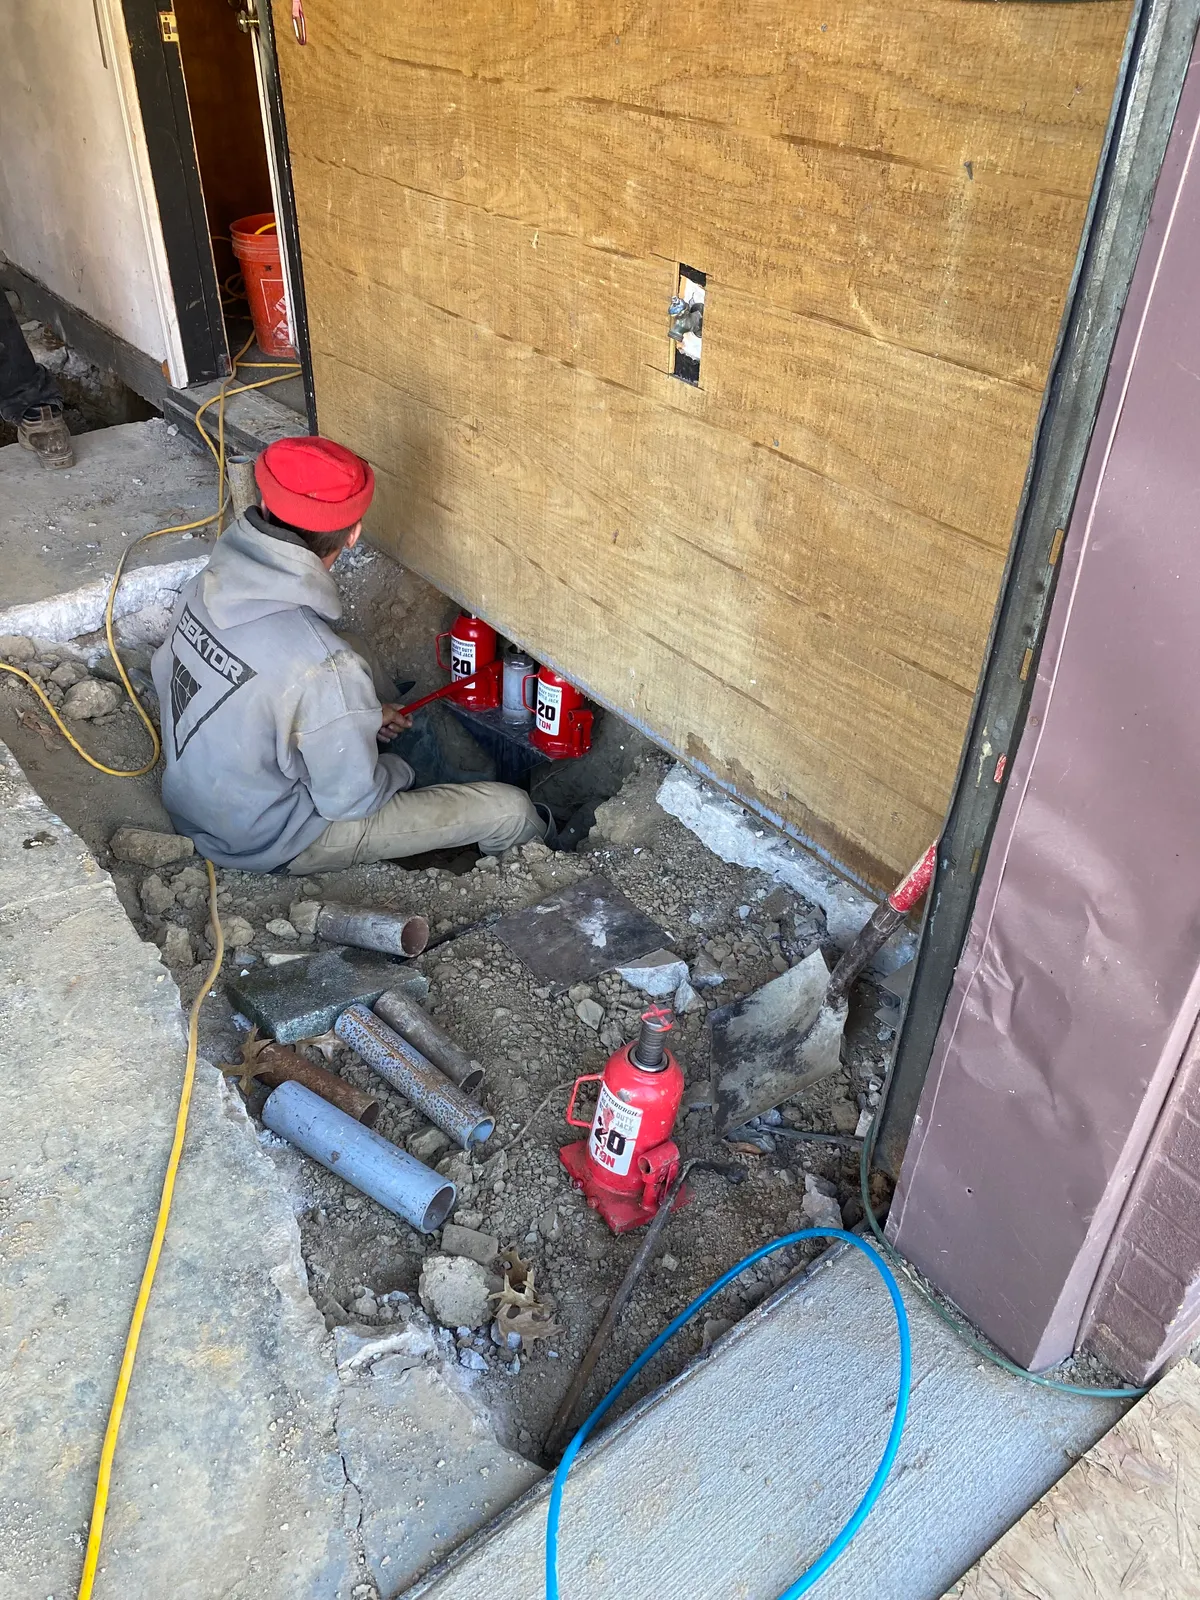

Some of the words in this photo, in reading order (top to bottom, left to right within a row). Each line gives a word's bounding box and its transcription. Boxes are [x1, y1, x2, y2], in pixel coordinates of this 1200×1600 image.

[178, 610, 243, 685] SEKTOR
[453, 656, 471, 676] 20
[538, 700, 556, 721] 20
[538, 718, 551, 730] TON
[603, 1087, 638, 1117] PITTSBURGH
[615, 1121, 634, 1132] JACK
[616, 1112, 634, 1126] DUTY
[595, 1143, 616, 1168] TON
